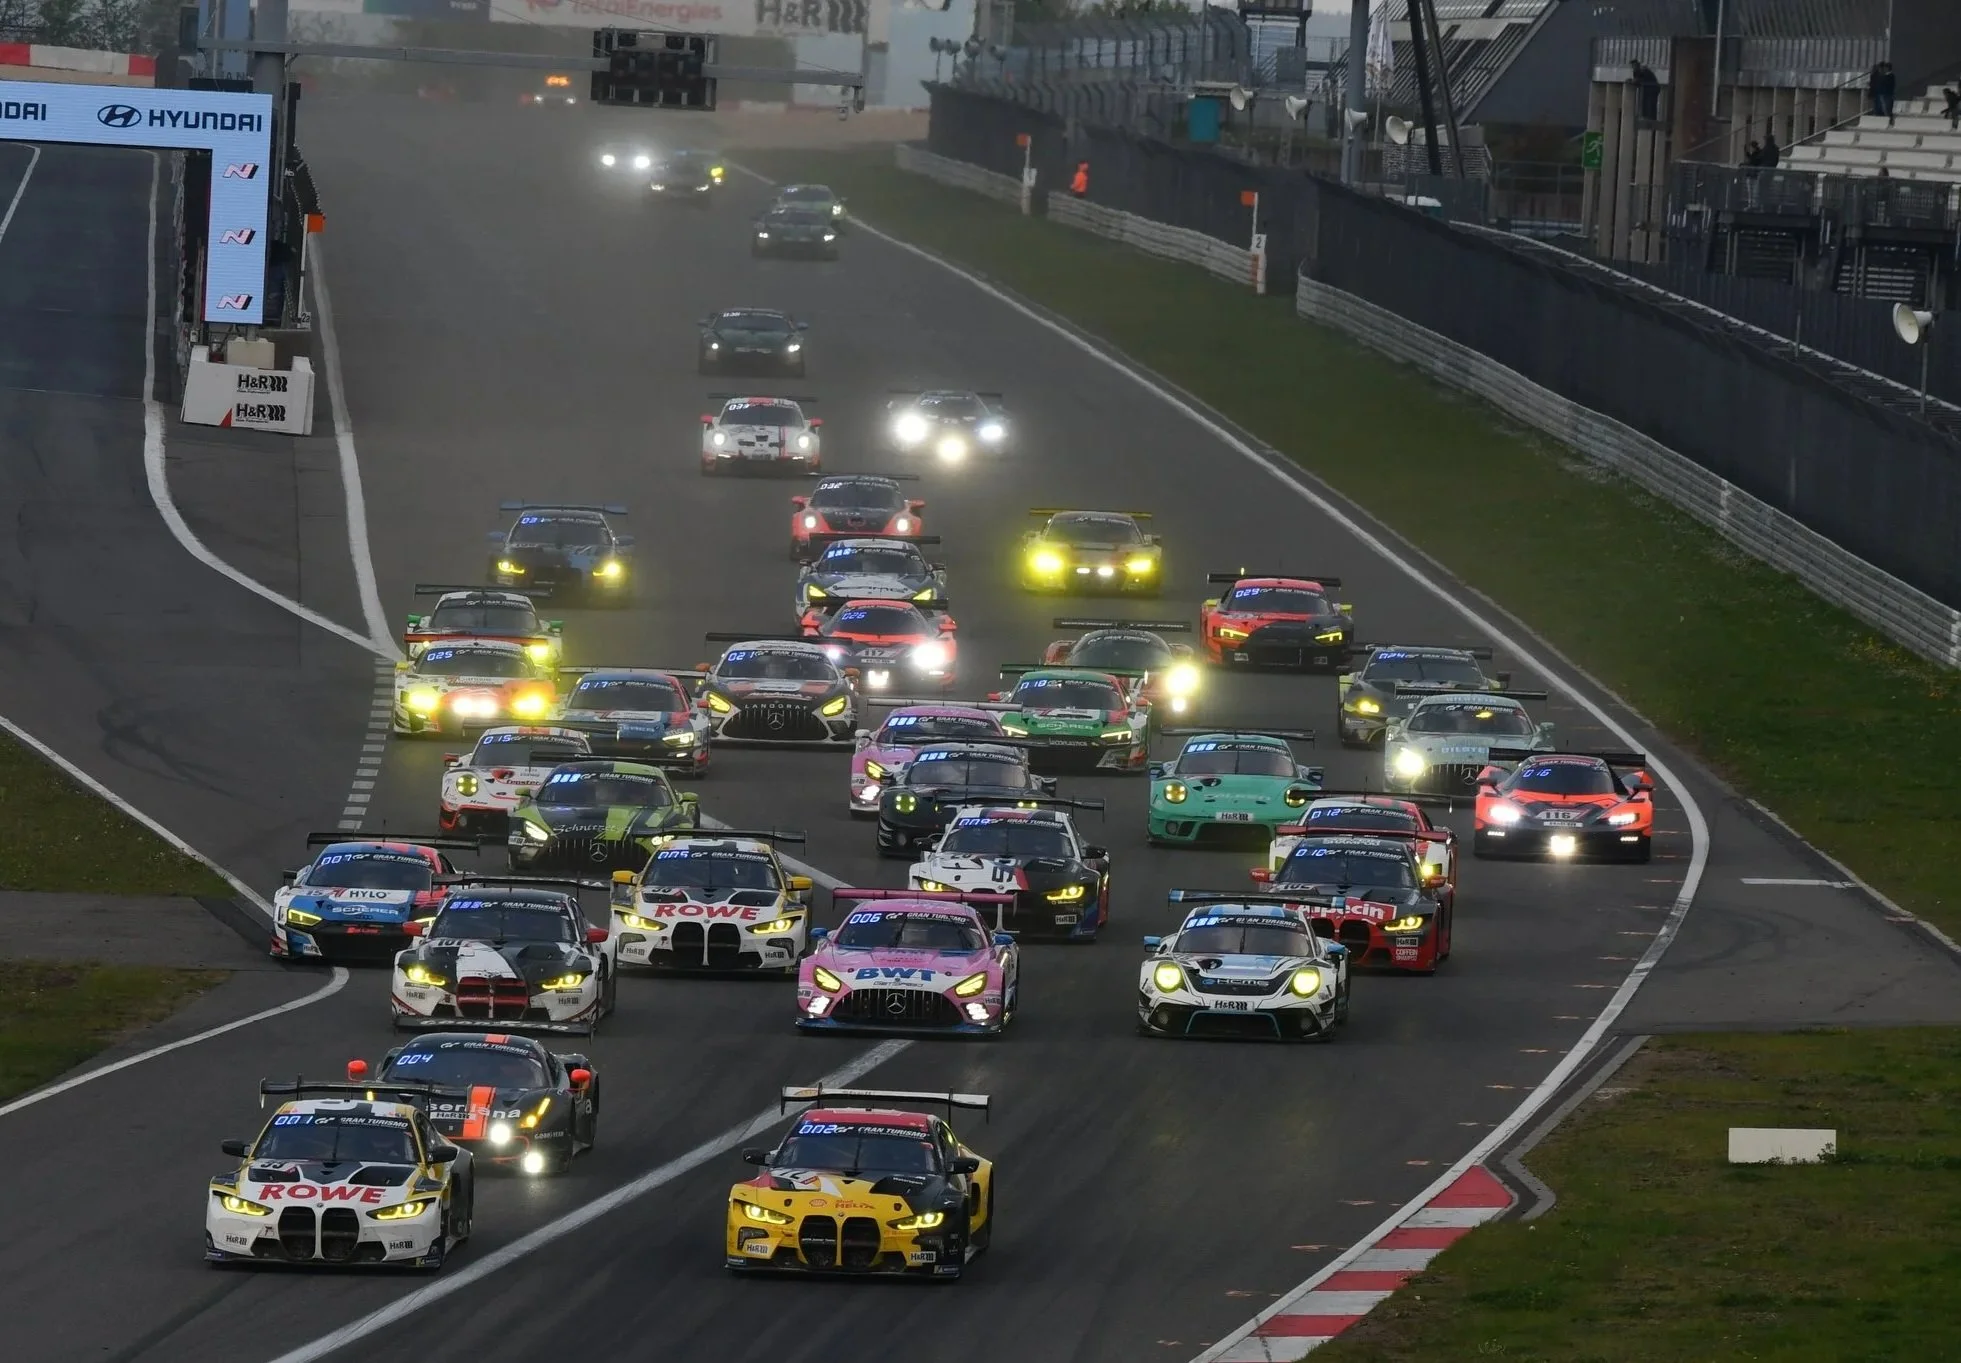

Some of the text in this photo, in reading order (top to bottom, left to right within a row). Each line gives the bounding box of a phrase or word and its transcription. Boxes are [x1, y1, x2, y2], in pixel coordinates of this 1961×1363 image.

[149, 109, 262, 132] HYUNDAI
[321, 853, 352, 866] 007
[349, 890, 387, 899] HYLO
[654, 904, 761, 920] ROWE
[849, 913, 882, 925] 006
[856, 967, 936, 982] BWT
[491, 1043, 529, 1055] TURISMO
[396, 1053, 434, 1066] 004
[274, 1115, 314, 1126] 001
[340, 1116, 366, 1124] GRAN
[368, 1117, 409, 1128] TURISMO
[799, 1124, 838, 1135] 002
[886, 1127, 927, 1138] TURISMO
[258, 1183, 387, 1204] ROWE
